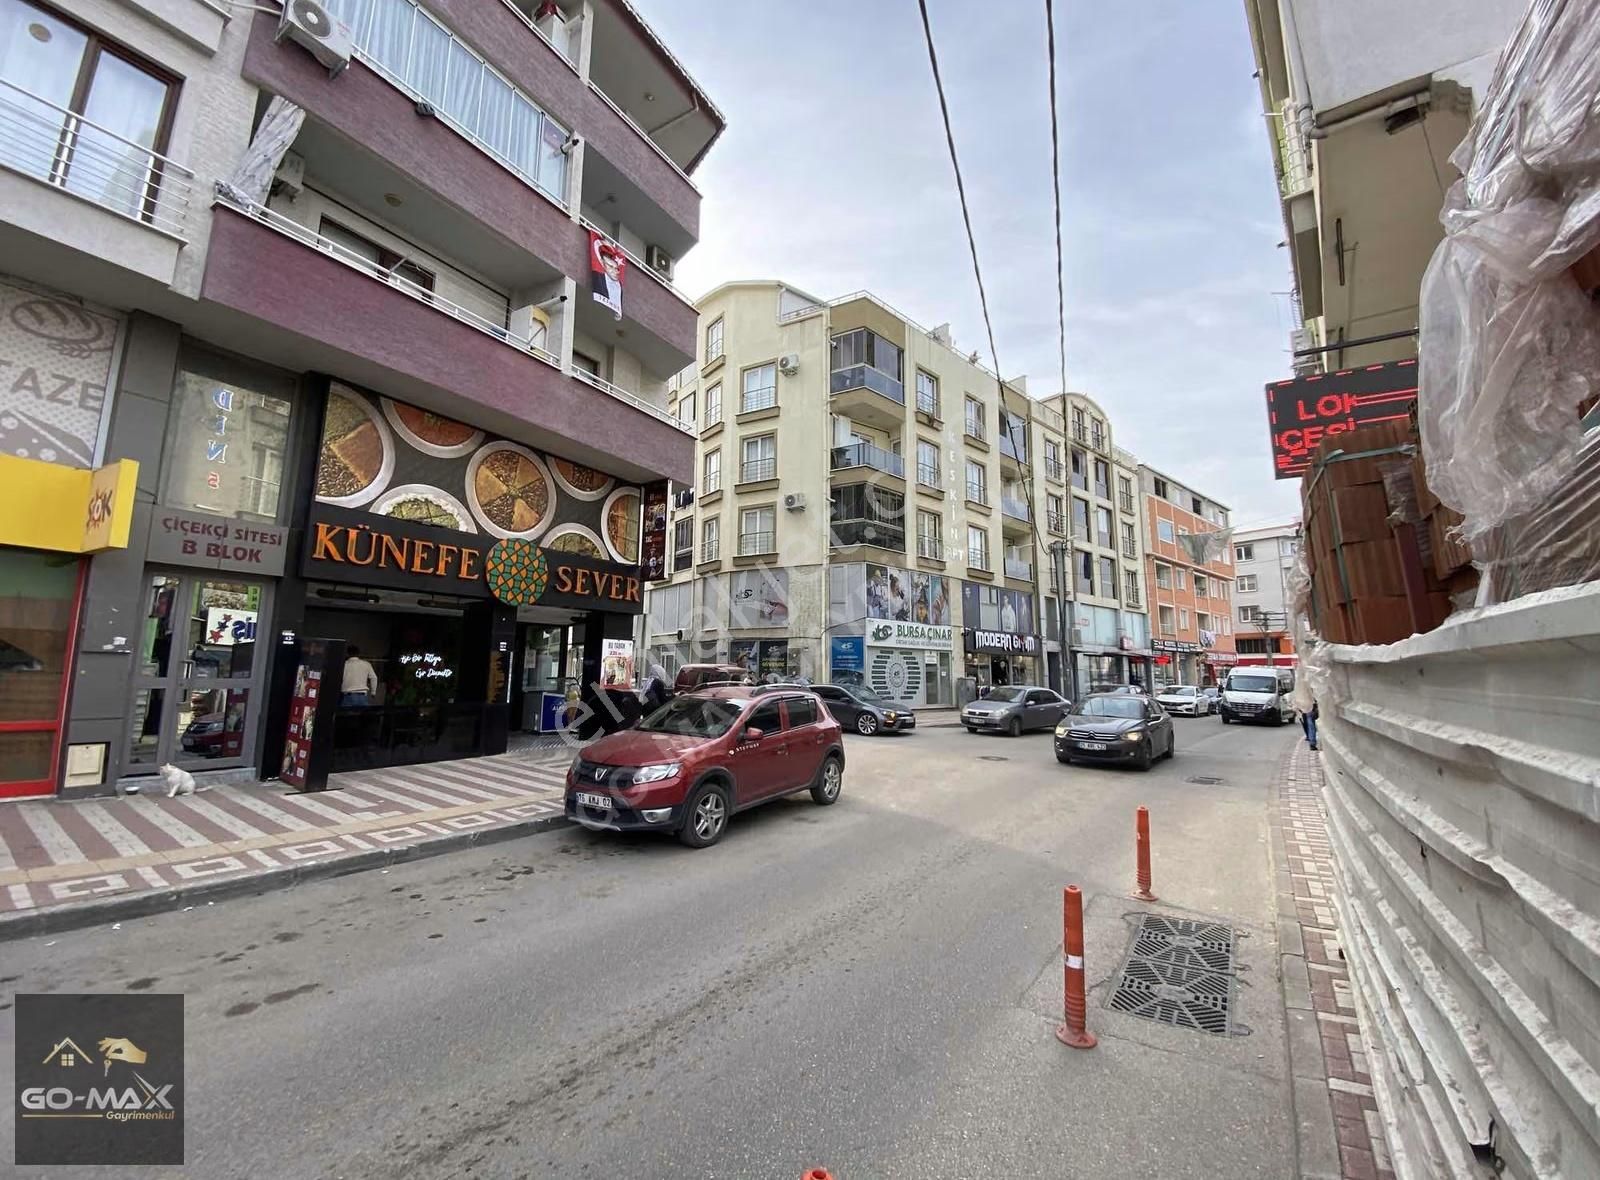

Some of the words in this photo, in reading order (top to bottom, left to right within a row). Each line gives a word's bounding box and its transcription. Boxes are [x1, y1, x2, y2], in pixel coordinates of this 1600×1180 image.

[162, 516, 229, 540] ÇİÇEKÇİ
[234, 527, 282, 546] SİTESİ
[181, 539, 198, 555] B
[206, 542, 262, 563] BLOK
[311, 521, 481, 580] KÜNEFE
[554, 565, 641, 603] SEVER
[896, 624, 926, 639] BURSA
[926, 627, 953, 641] ÇINAR
[975, 630, 1012, 652] MODERN
